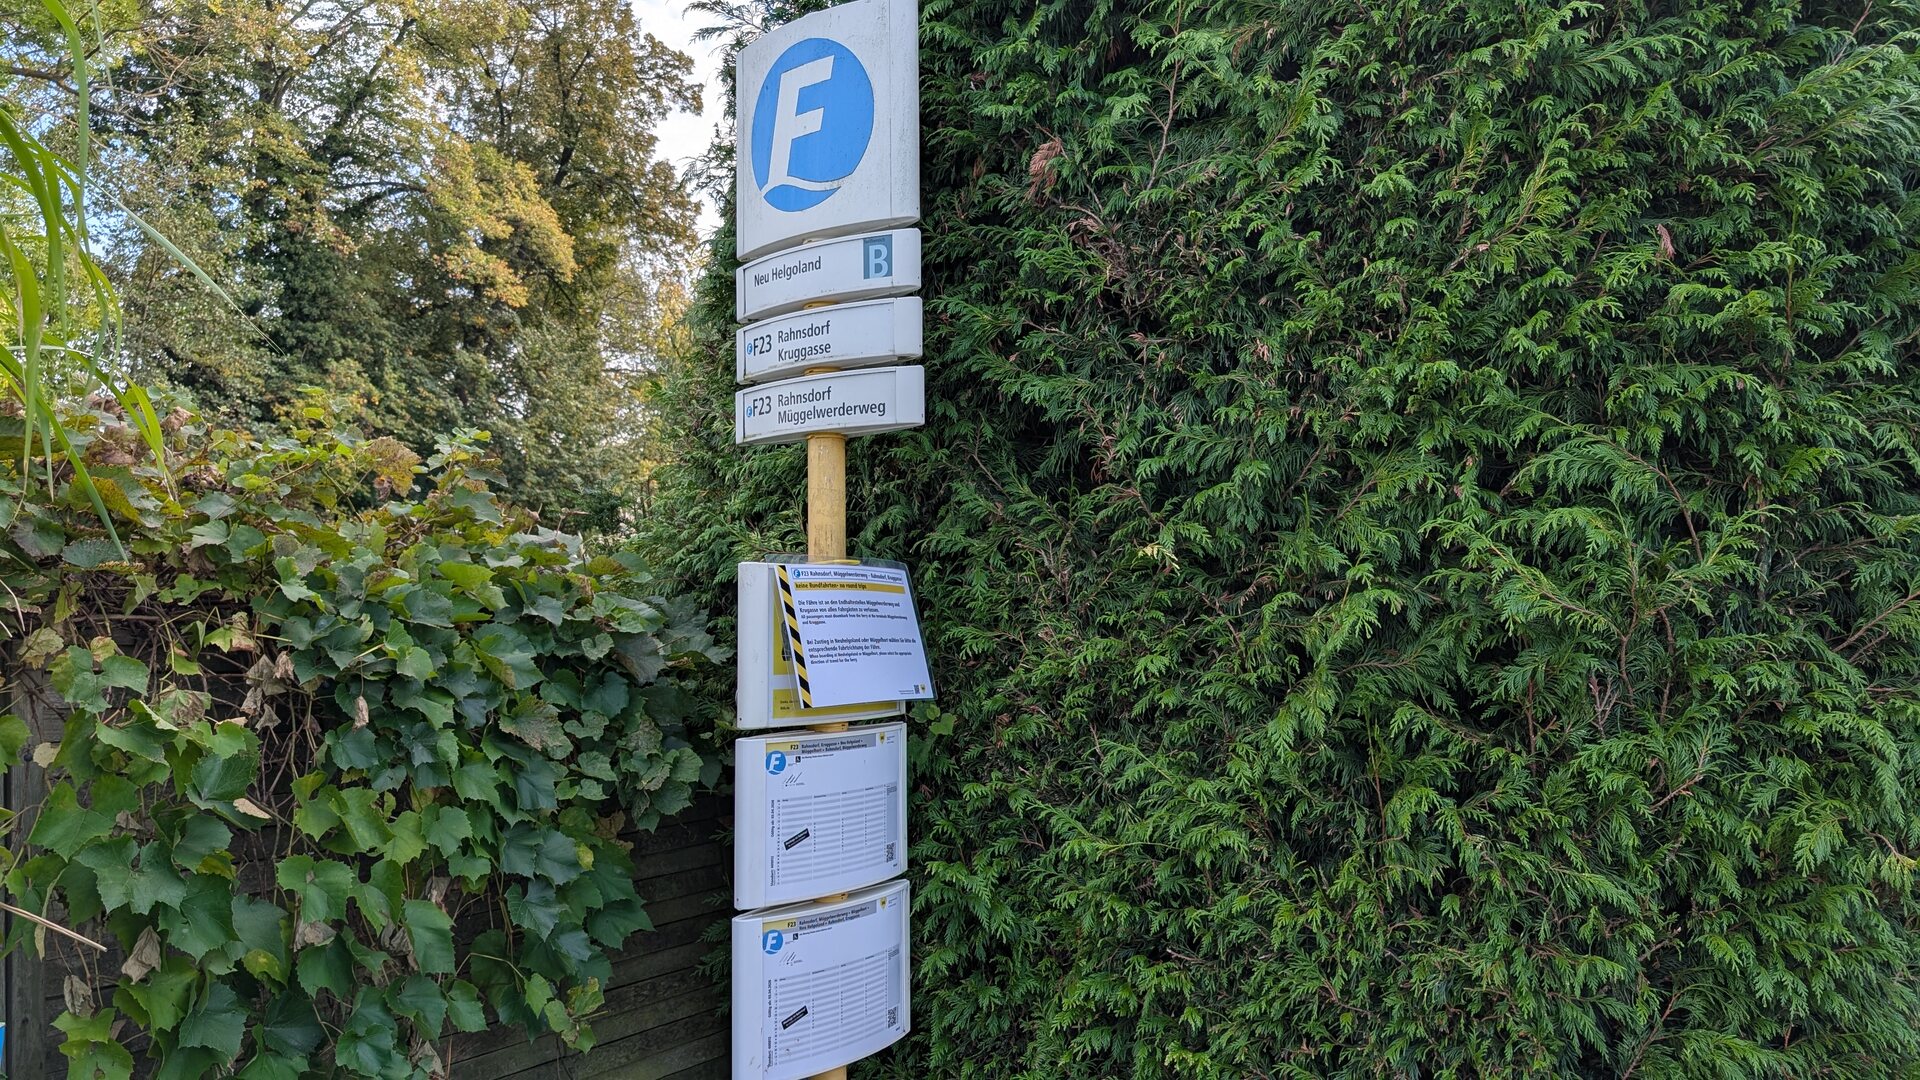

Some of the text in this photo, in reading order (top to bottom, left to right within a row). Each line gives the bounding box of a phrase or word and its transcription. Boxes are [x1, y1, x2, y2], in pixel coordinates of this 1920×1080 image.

[754, 256, 822, 287] Neu Helgoland
[869, 244, 888, 278] B
[778, 320, 831, 343] Rahnsdorf
[753, 334, 772, 356] F23
[778, 342, 831, 362] Kruggasse
[752, 395, 772, 417] F23
[778, 386, 832, 407] Rahnsdorf
[778, 401, 886, 425] Müggelwerderweg
